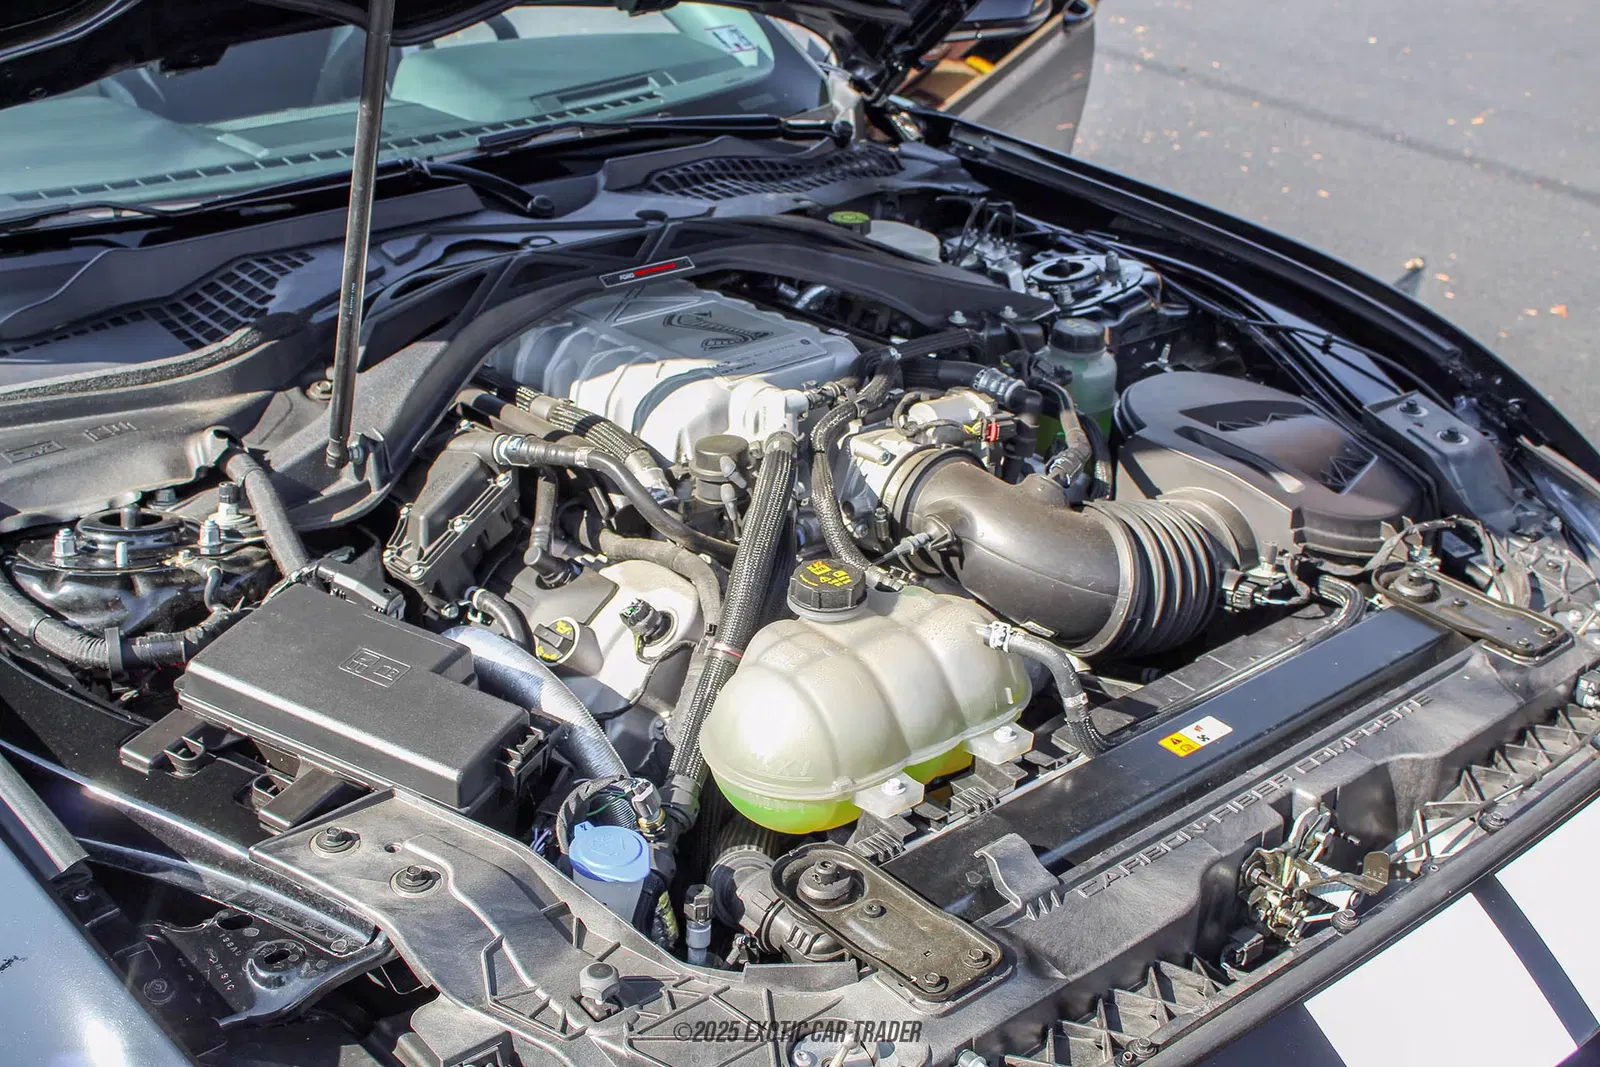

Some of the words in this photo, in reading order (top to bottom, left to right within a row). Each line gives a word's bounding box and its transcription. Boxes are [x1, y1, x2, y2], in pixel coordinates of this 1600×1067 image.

[1077, 822, 1208, 899] CARBON
[1208, 773, 1295, 824] FIBER
[1295, 692, 1434, 775] COMPOSITE
